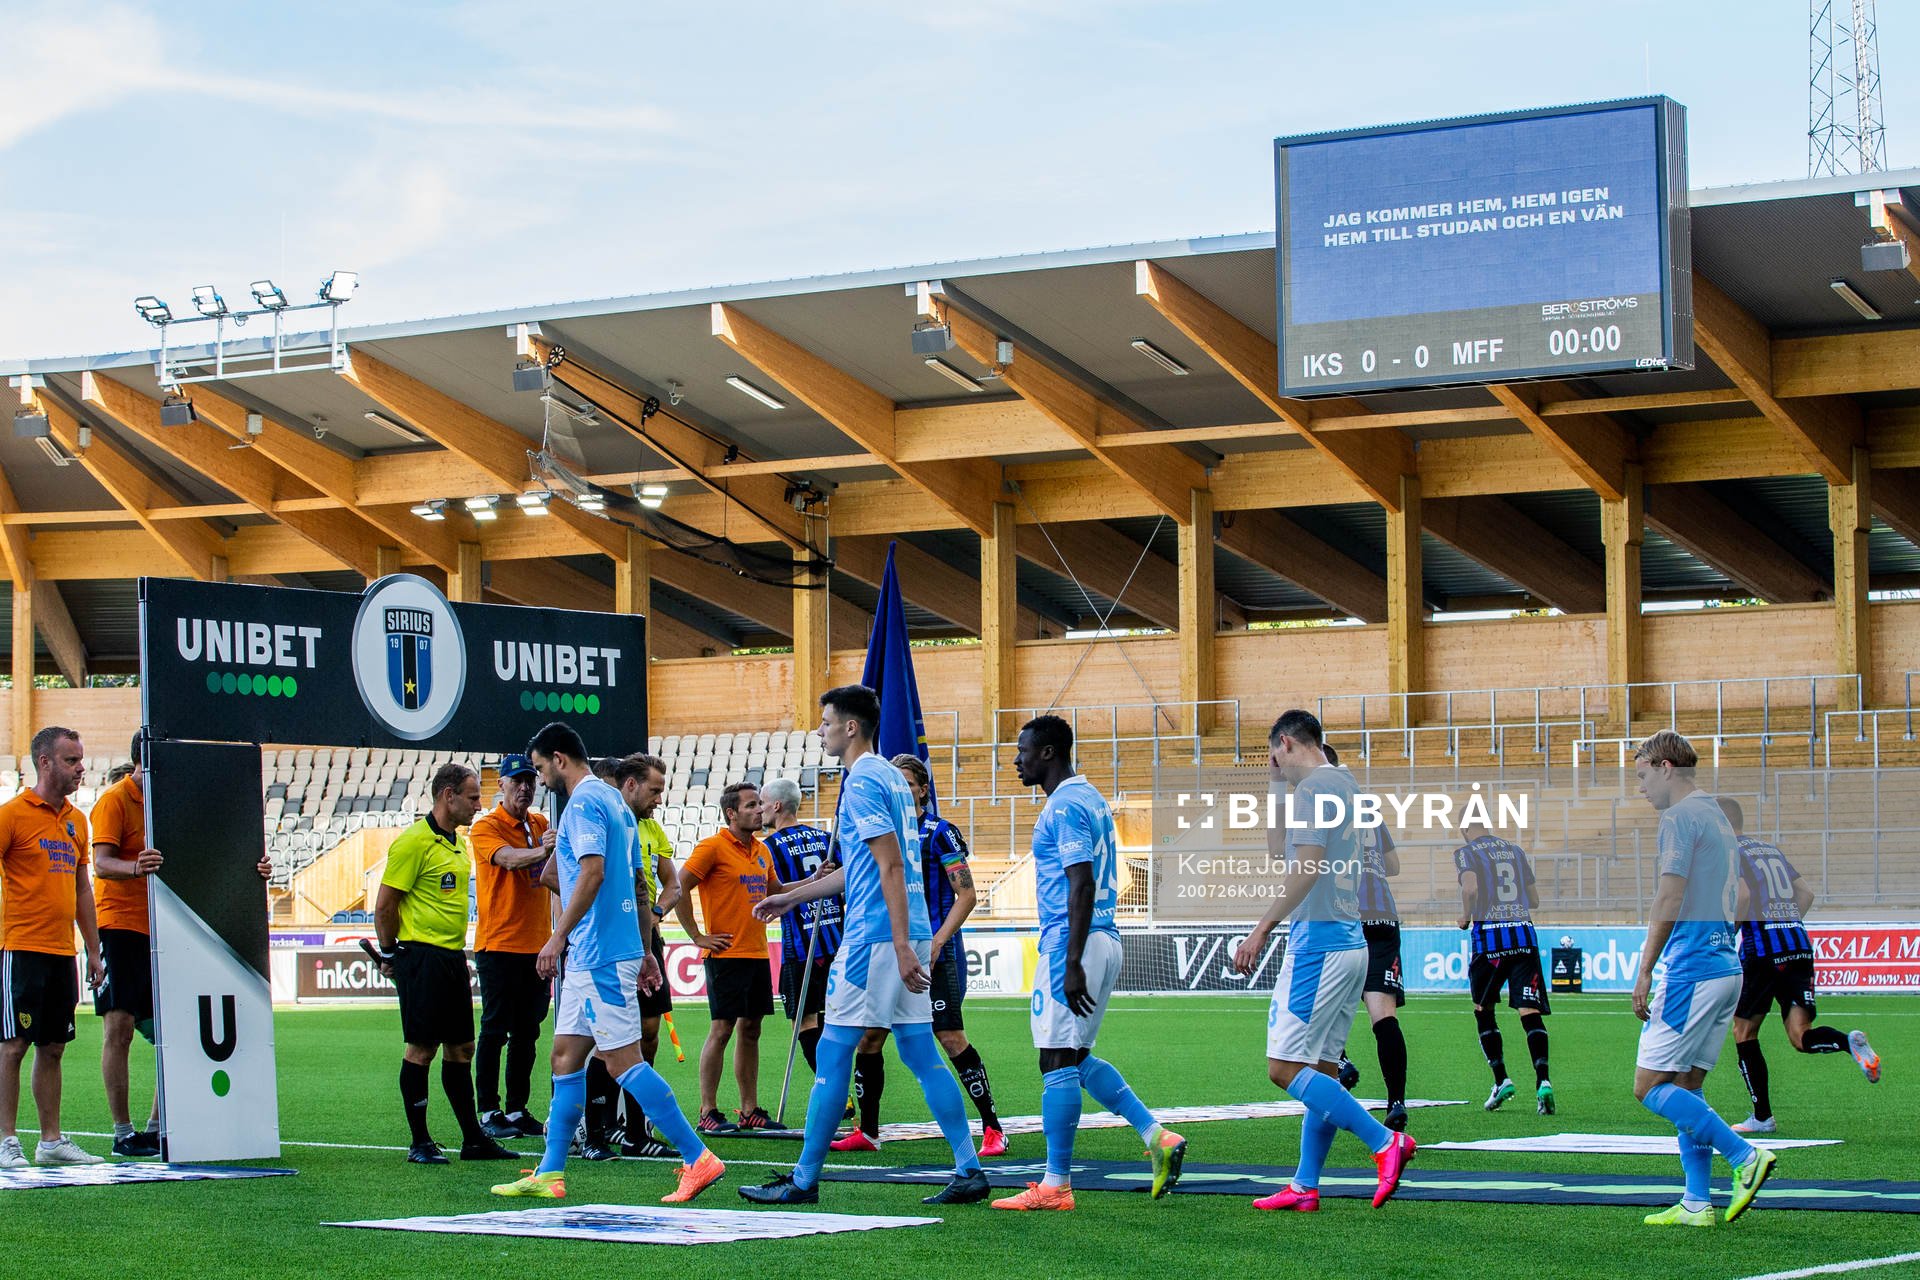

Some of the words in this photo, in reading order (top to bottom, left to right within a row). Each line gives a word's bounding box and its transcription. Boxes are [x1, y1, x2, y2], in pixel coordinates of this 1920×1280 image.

[1323, 212, 1361, 228] JAG
[1366, 204, 1453, 222] KOMMER
[1458, 198, 1507, 214] HEM,
[1512, 191, 1556, 209] HEM
[1561, 187, 1609, 205] IGEN
[1324, 230, 1367, 247] HEM
[1371, 225, 1413, 242] TILL
[1417, 218, 1497, 238] STUDAN
[1503, 212, 1543, 230] OCH
[1549, 207, 1576, 224] EN
[1581, 205, 1624, 221] VÄN
[1549, 324, 1621, 356] 00:00
[1303, 352, 1344, 378] IKS
[1361, 350, 1376, 373] 0
[1414, 345, 1430, 369] 0
[1453, 338, 1504, 366] MFF
[1635, 357, 1667, 368] LEDtec
[387, 611, 431, 633] SIRIUS
[176, 617, 322, 669] UNIBET
[390, 637, 400, 649] 19
[419, 639, 428, 651] 07
[493, 640, 622, 687] UNIBET
[788, 841, 827, 856] HELLBORG
[1496, 862, 1518, 901] 3
[1755, 858, 1794, 899] 10
[1812, 937, 1891, 960] KSALA
[584, 997, 597, 1024] 4
